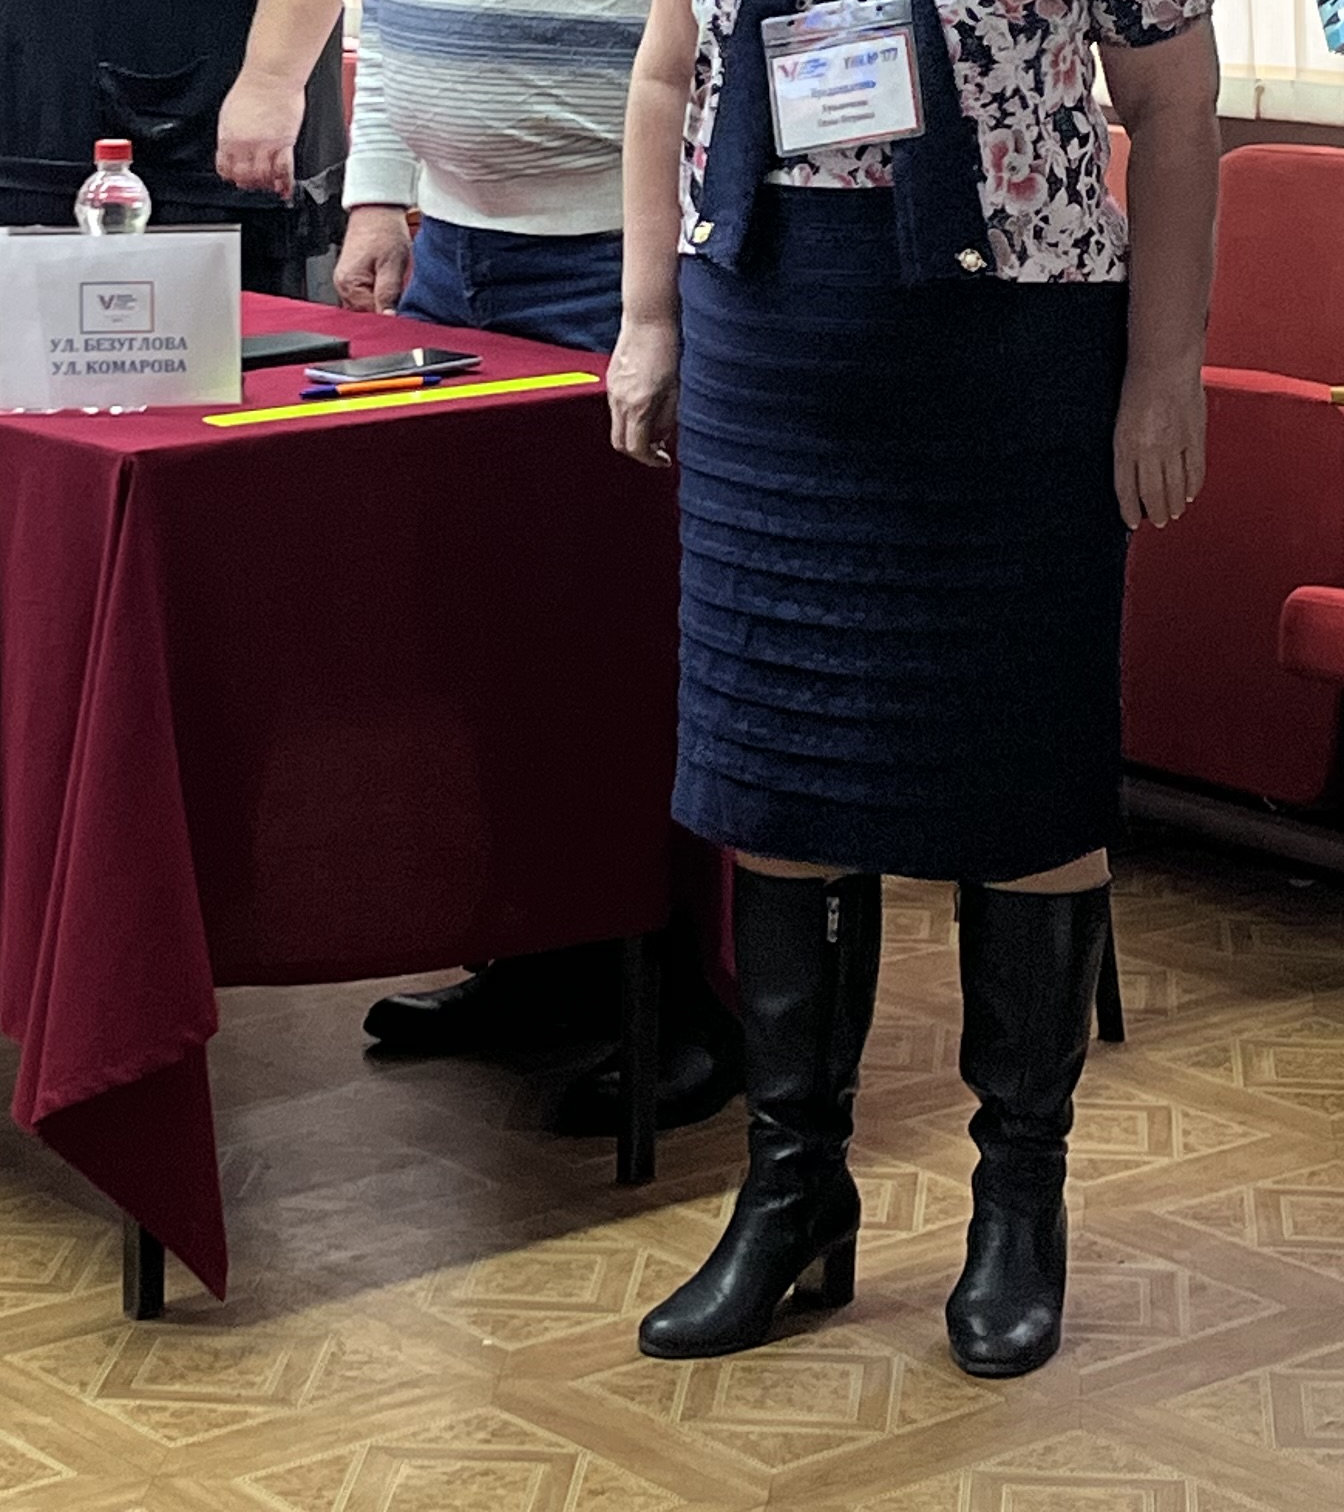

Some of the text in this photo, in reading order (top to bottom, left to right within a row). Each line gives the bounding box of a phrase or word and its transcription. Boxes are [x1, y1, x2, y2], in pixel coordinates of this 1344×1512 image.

[50, 336, 188, 353] УЛ. БЕЗУГЛОВА
[51, 359, 187, 376] УЛ. КОМАРОВА
